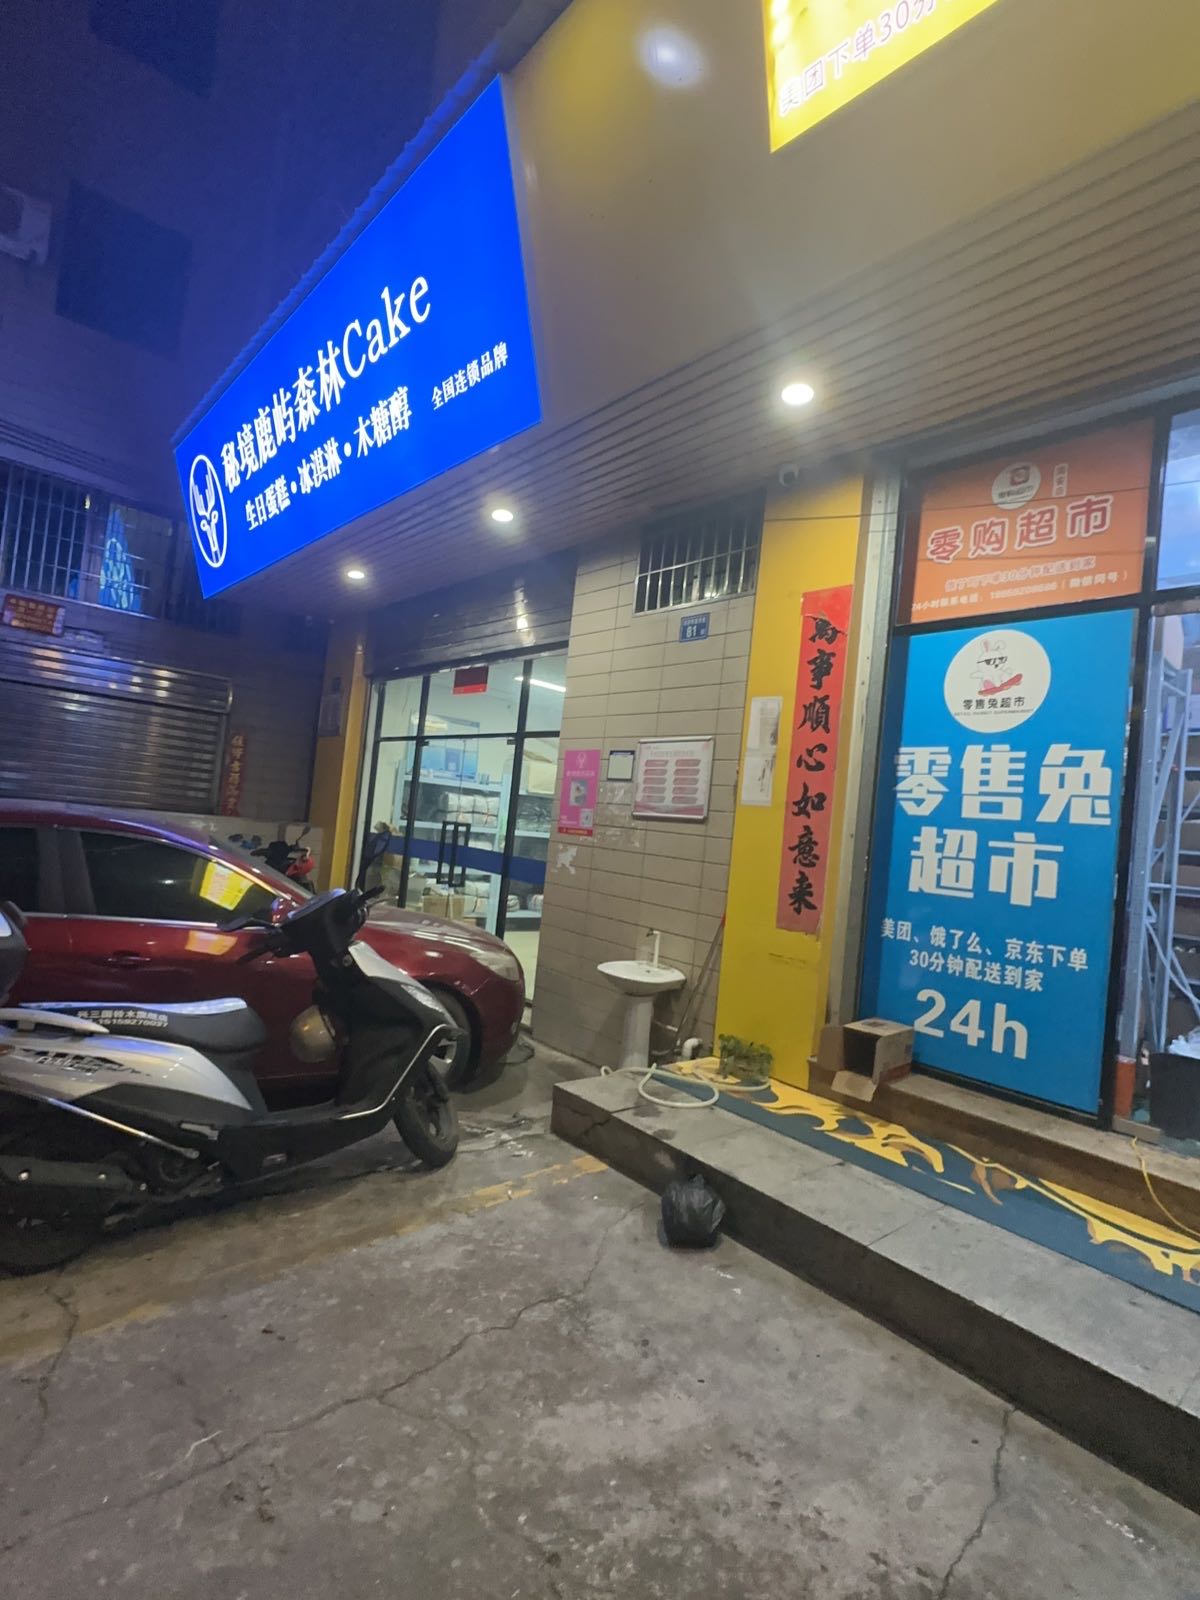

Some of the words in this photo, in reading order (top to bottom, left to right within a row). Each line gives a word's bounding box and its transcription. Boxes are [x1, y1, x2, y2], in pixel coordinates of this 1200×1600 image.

[220, 276, 430, 492] 秘境鹿屿森林Cake
[431, 341, 508, 411] 全国连锁品牌
[928, 496, 1113, 564] 零购超市
[962, 696, 1025, 710] 零售兔超市
[894, 743, 1112, 826] 零售兔
[908, 826, 1064, 907] 超市
[881, 917, 1089, 972] 美团、饿了么、京东下单
[909, 949, 1044, 992] 30分钟配送到家
[913, 988, 1029, 1060] 24h
